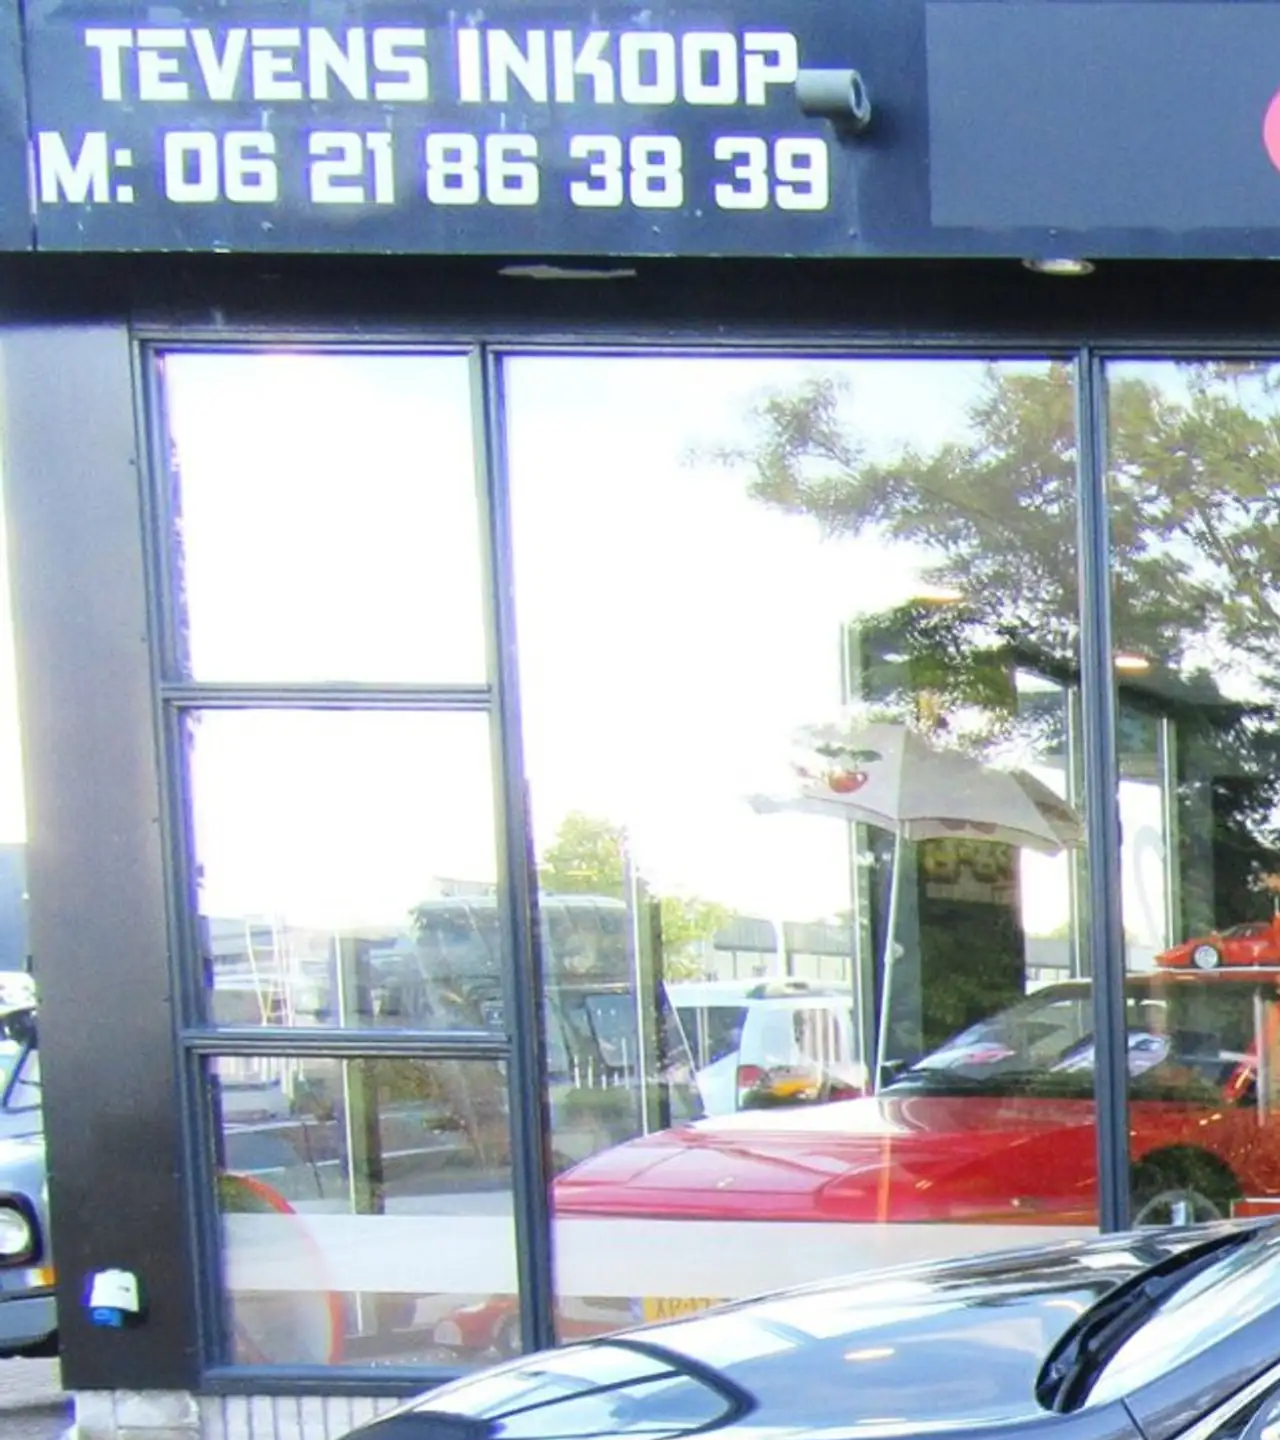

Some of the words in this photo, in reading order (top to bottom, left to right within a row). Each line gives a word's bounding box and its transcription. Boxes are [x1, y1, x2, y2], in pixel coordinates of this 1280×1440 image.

[85, 27, 429, 101] TEVENS
[457, 27, 798, 105] INKOOP
[40, 131, 133, 203] M:
[164, 130, 278, 203] 06
[309, 131, 395, 205] 21
[425, 132, 539, 205] 86
[570, 134, 683, 207] 38
[714, 136, 828, 210] 39
